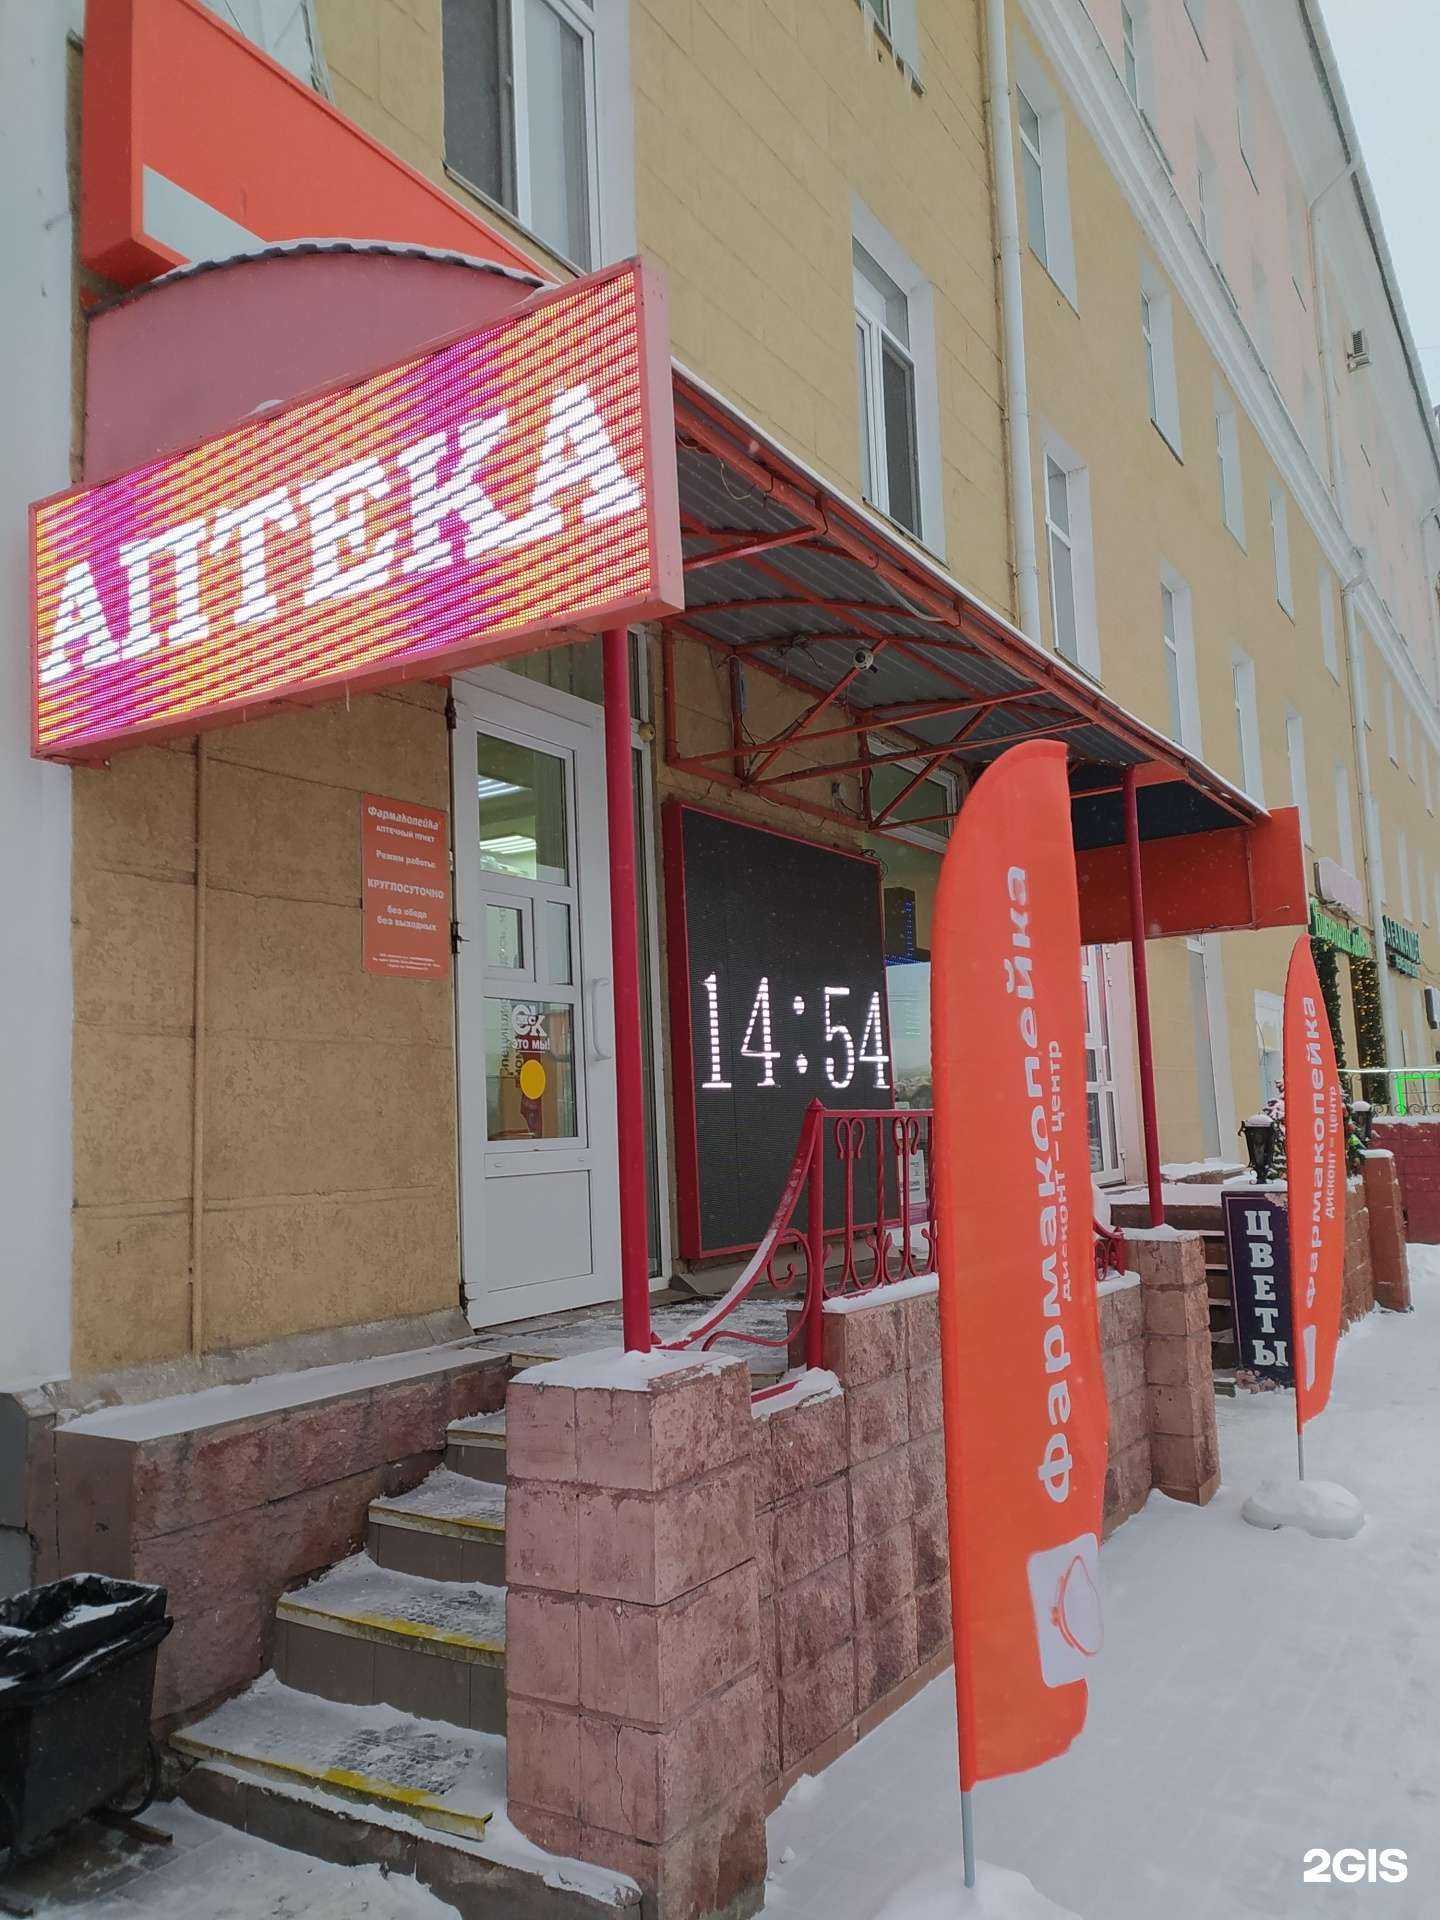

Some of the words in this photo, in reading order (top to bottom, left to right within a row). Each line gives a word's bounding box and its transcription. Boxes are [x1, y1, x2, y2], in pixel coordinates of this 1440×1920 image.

[38, 381, 643, 684] АПТЕКА
[368, 878, 444, 899] КРУГЛОСУТОЧНО
[699, 971, 891, 1089] 14:54
[1004, 866, 1073, 1503] Фармакопейка
[1303, 996, 1325, 1309] Фармакопейка
[1244, 1210, 1289, 1367] ЦВЕТЫ
